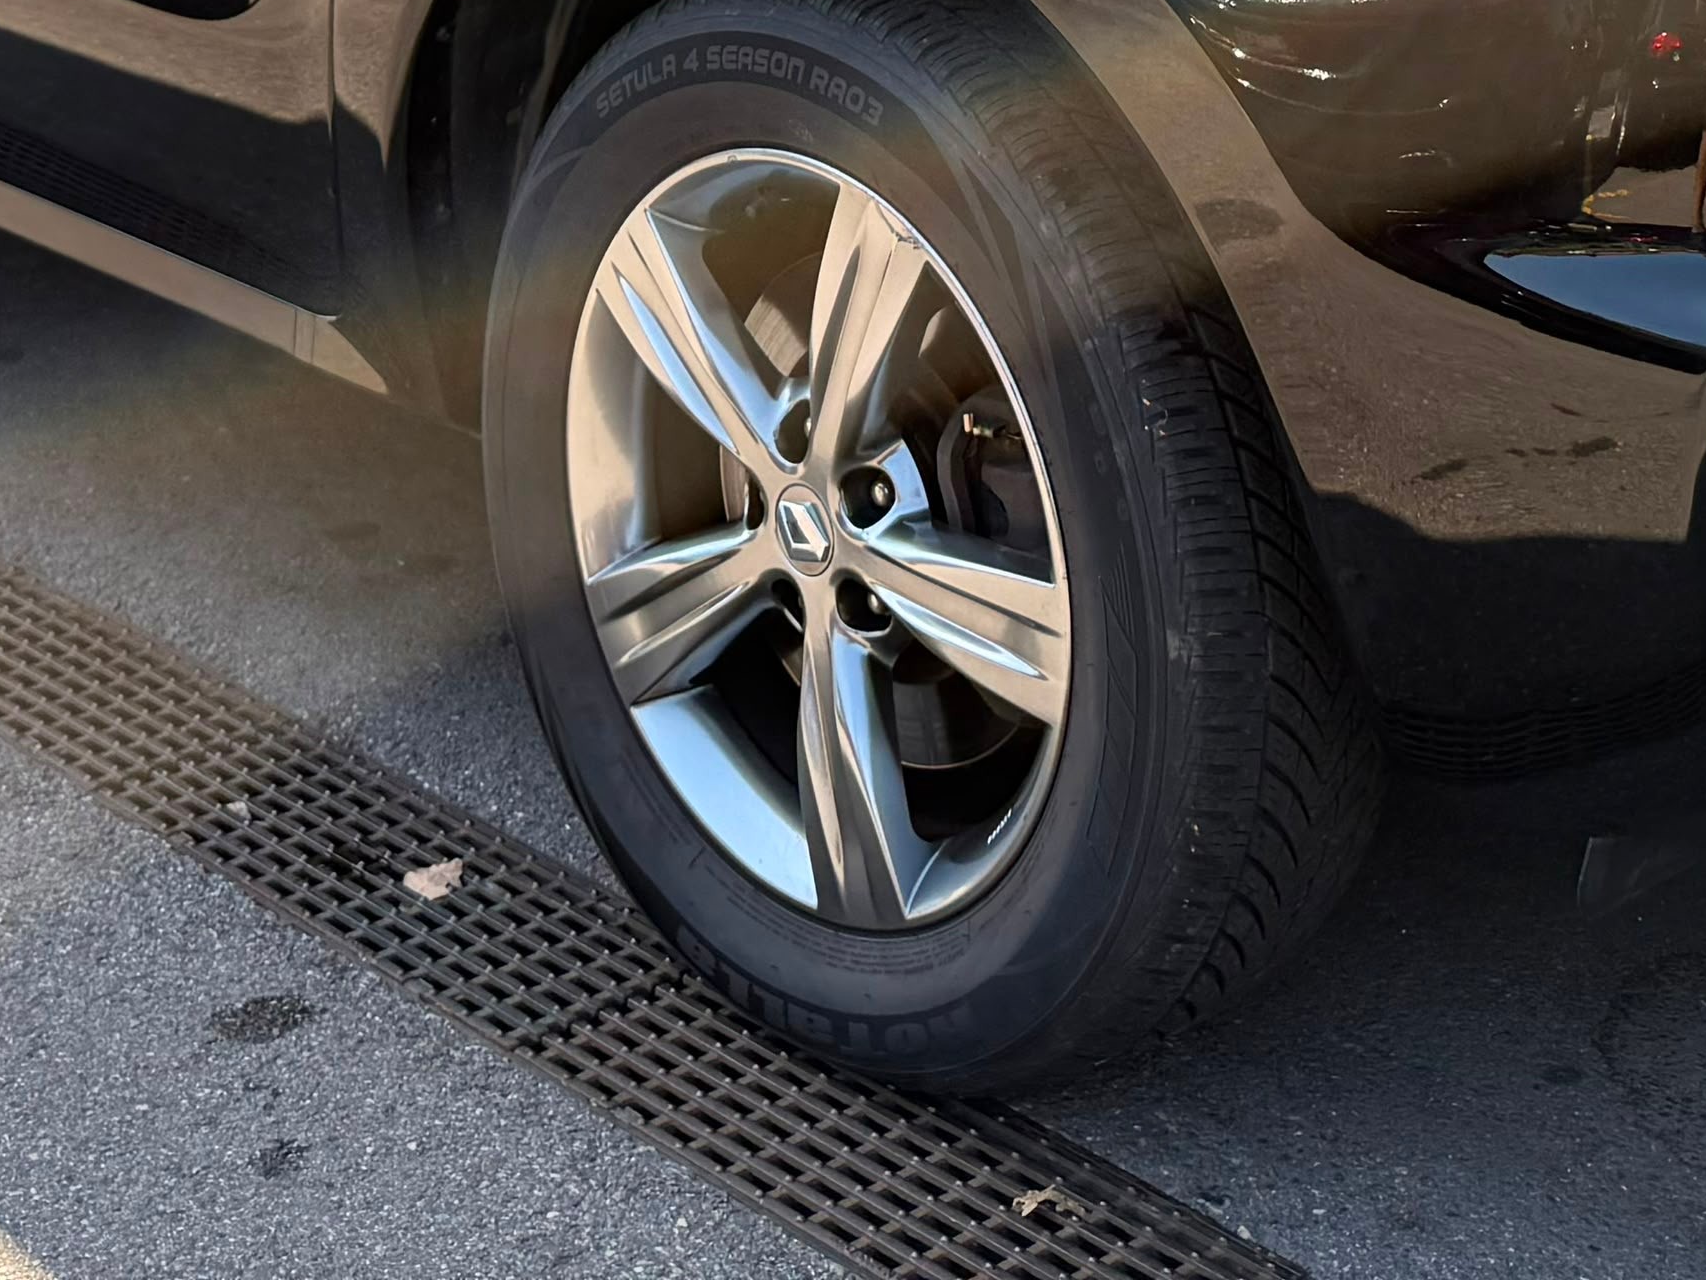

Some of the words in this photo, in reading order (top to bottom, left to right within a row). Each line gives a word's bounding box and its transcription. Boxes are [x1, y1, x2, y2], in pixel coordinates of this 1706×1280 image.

[596, 53, 676, 118] SETULA
[683, 48, 699, 72] 4
[706, 45, 805, 83] SEASON
